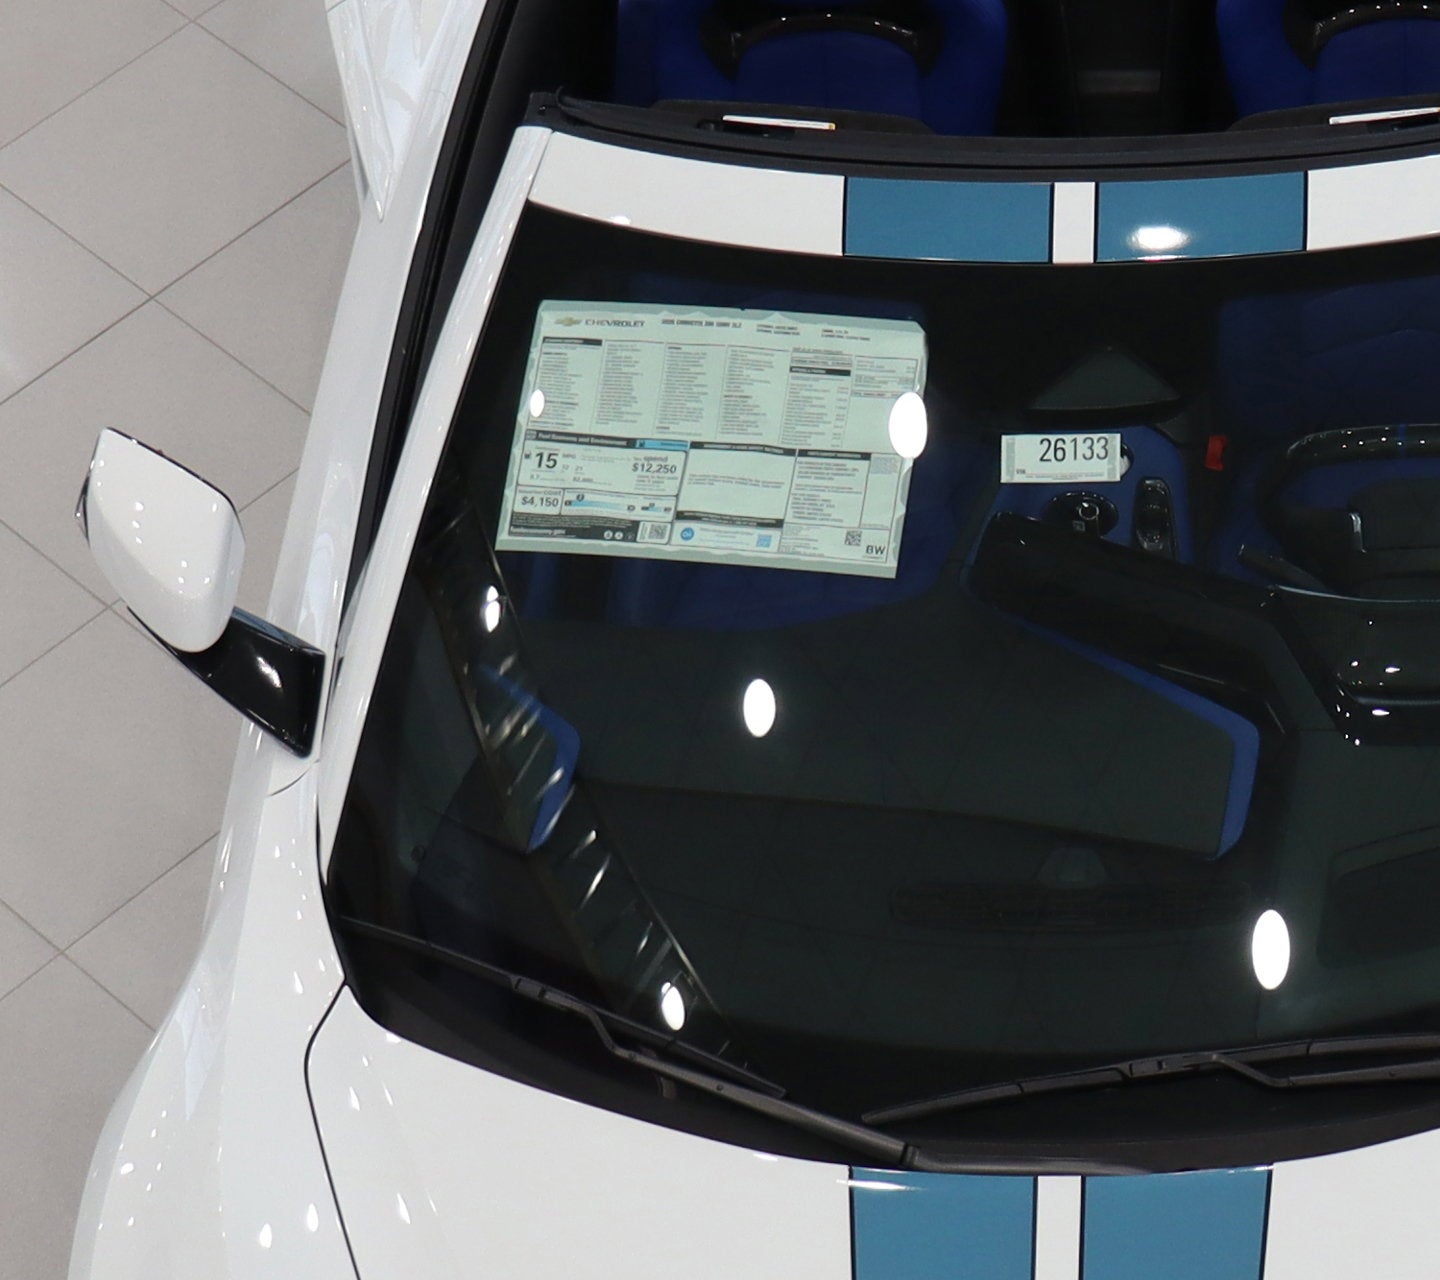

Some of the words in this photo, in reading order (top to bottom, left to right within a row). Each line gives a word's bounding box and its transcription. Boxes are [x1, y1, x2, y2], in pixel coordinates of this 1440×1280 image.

[585, 319, 646, 328] CHEVROLET
[1039, 436, 1109, 463] 26133
[535, 452, 559, 469] 15
[632, 462, 677, 474] $12,250
[521, 496, 559, 508] $4,150
[865, 544, 886, 555] BW
